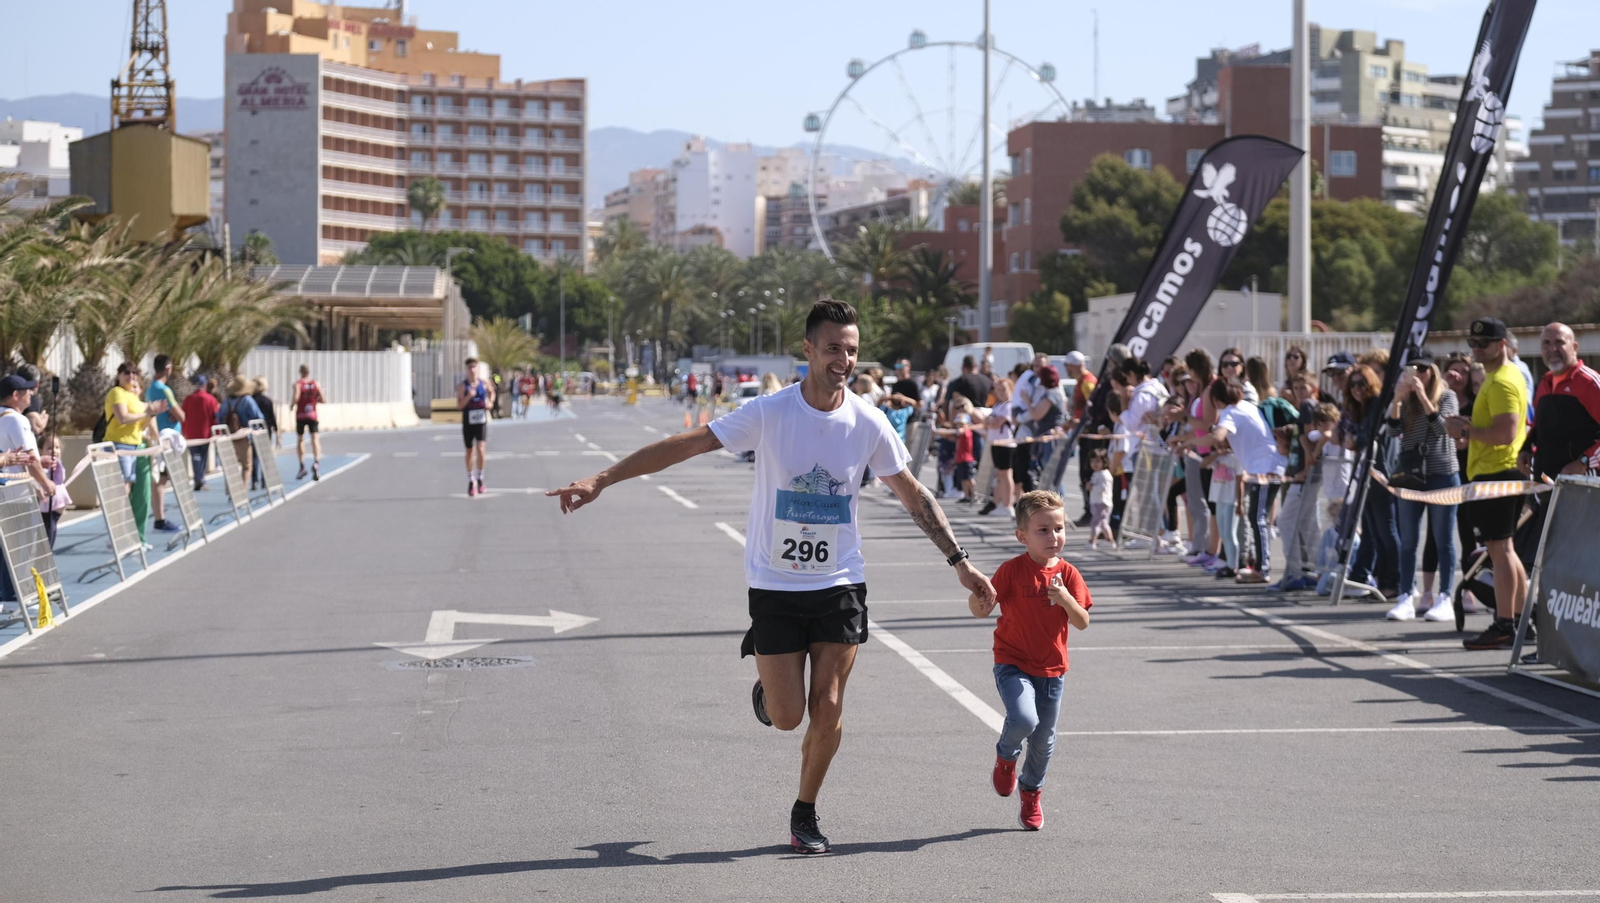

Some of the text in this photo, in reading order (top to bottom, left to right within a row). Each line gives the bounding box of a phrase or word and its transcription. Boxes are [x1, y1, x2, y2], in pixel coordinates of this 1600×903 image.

[237, 83, 309, 95] GRAN HOTEL
[785, 506, 840, 524] Fisioterapia
[781, 538, 829, 563] 296
[1547, 583, 1600, 631] aquéat
